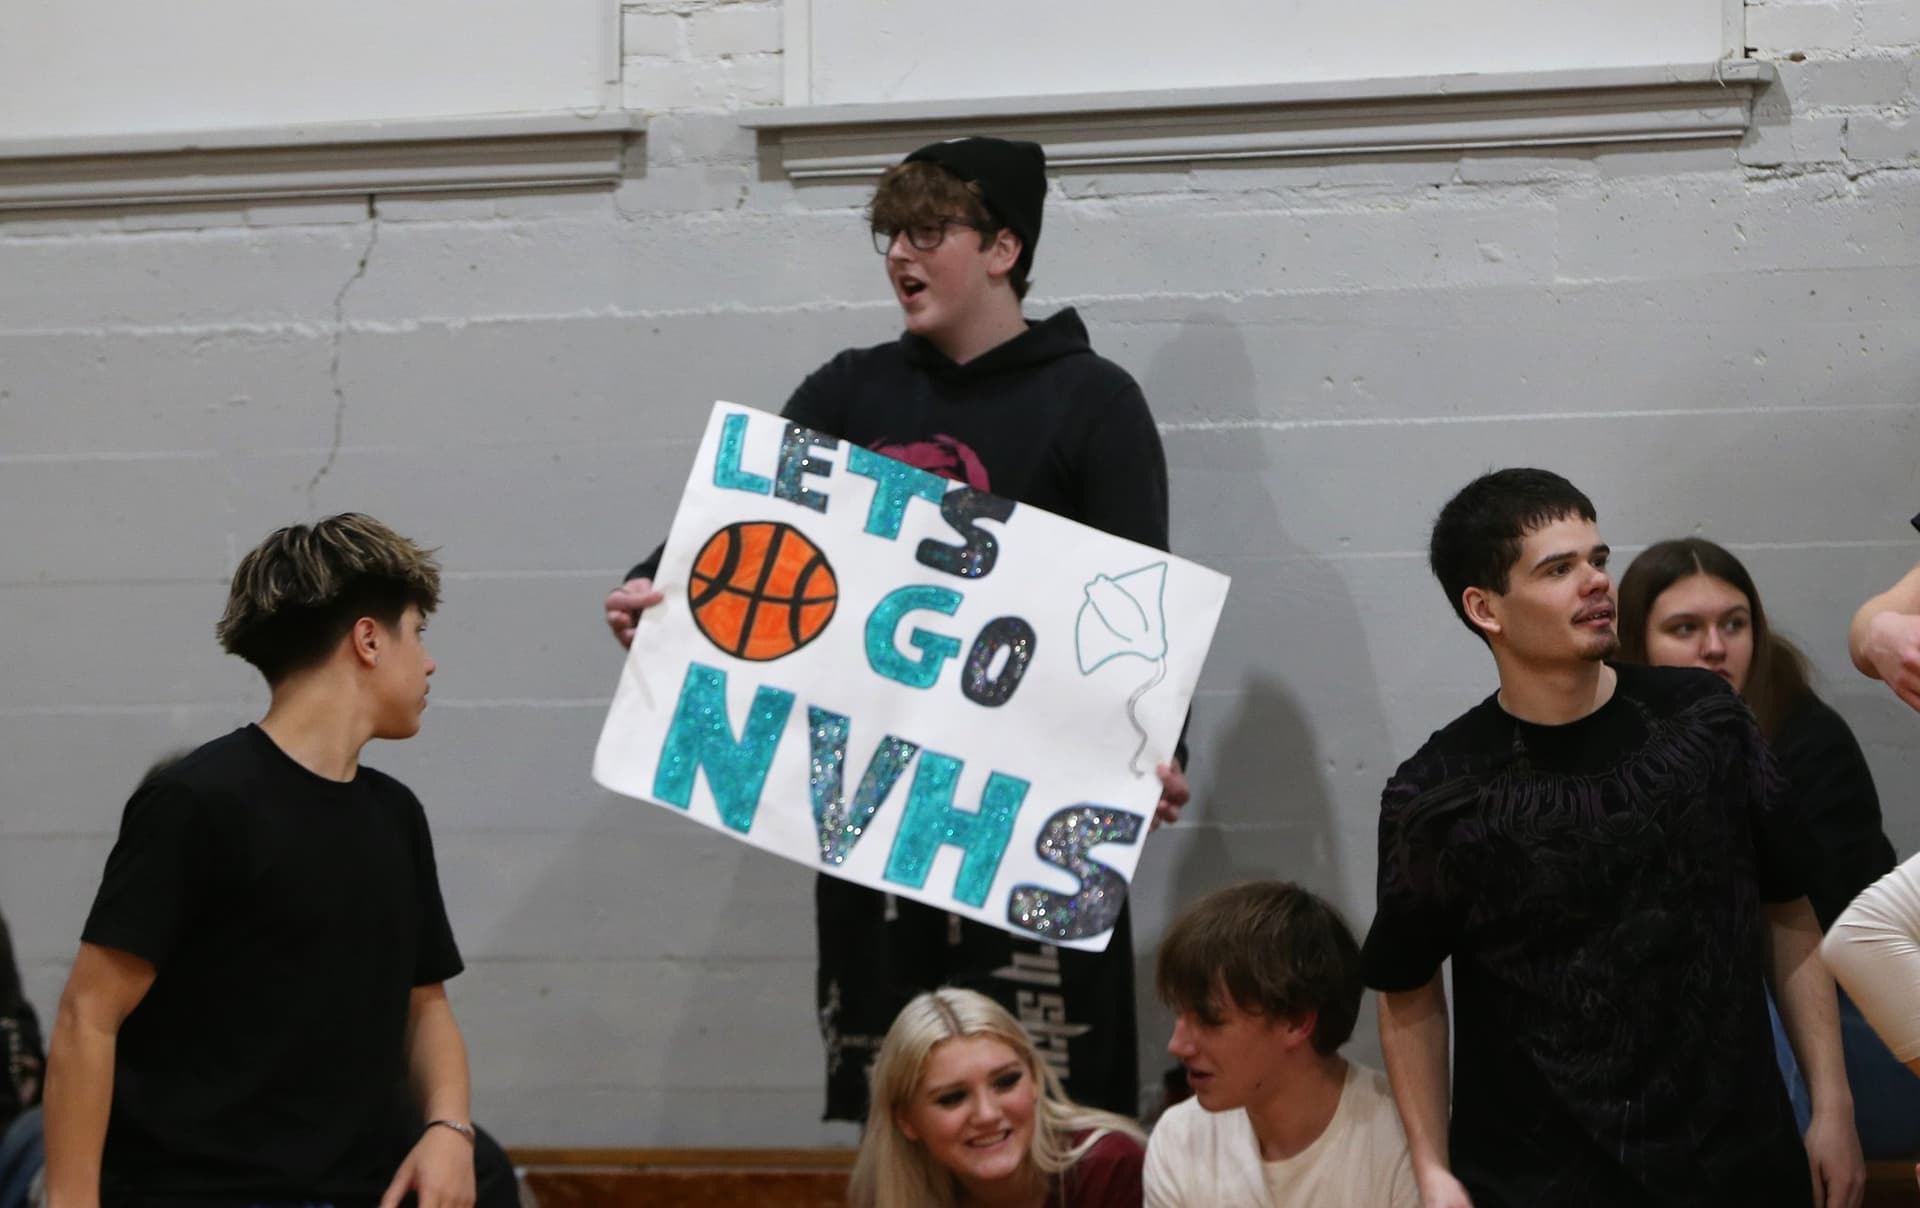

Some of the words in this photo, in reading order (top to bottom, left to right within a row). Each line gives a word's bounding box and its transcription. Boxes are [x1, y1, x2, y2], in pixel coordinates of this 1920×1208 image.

[713, 413, 1018, 580] LETS
[864, 584, 1037, 708] GO
[651, 661, 1146, 942] NVHS
